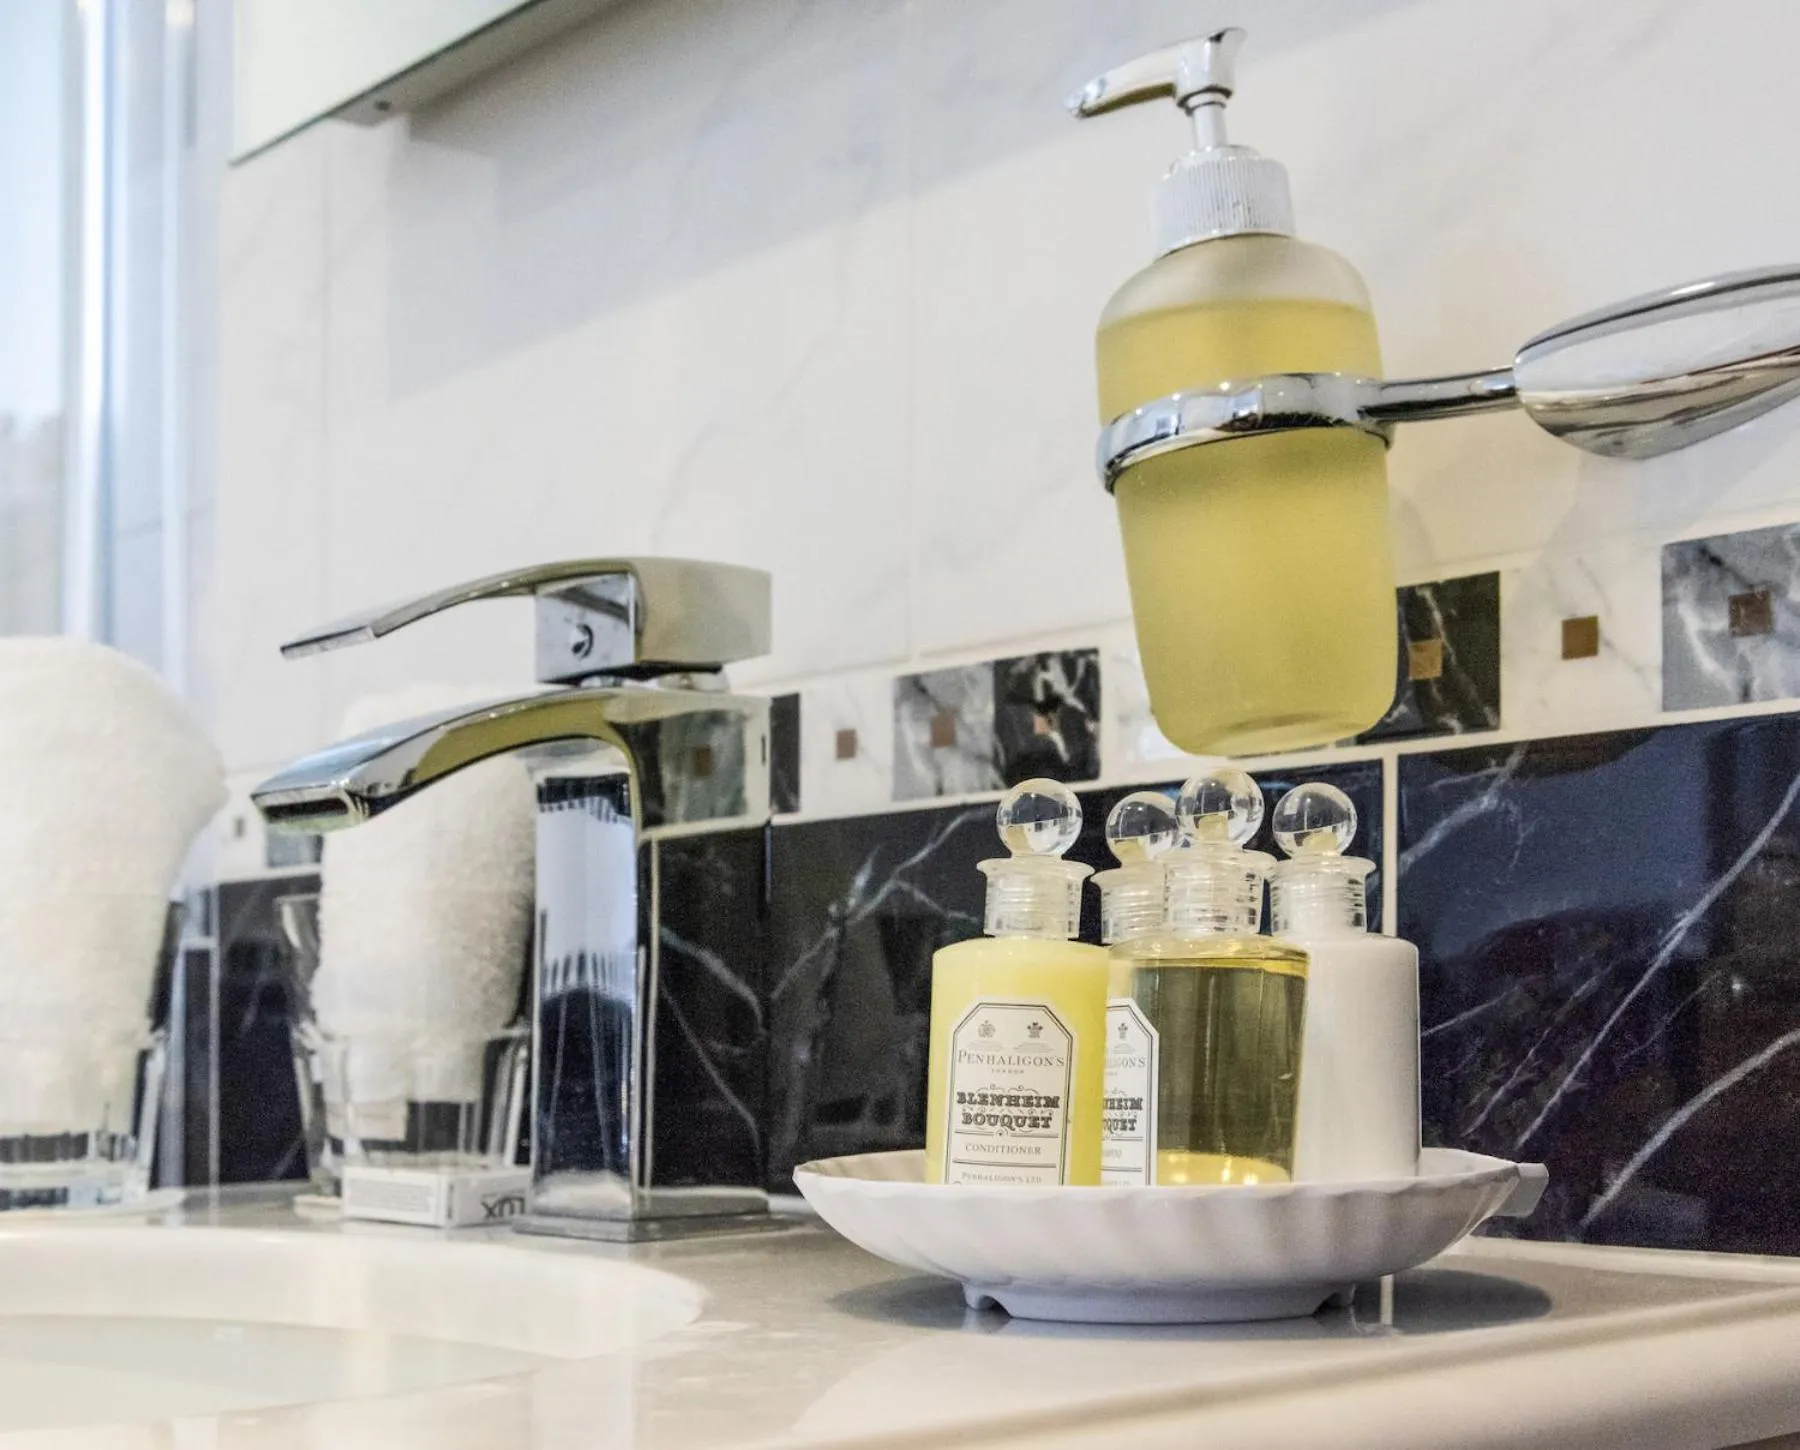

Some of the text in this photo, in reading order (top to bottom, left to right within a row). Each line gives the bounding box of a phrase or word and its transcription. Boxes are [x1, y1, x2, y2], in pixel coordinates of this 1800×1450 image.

[958, 1048, 1065, 1067] PENHALIGON'S
[957, 1091, 1061, 1109] BLENHEIM
[962, 1112, 1053, 1131] BOUQUET
[965, 1142, 1042, 1156] CONDITIONER
[480, 1197, 526, 1219] LUX
